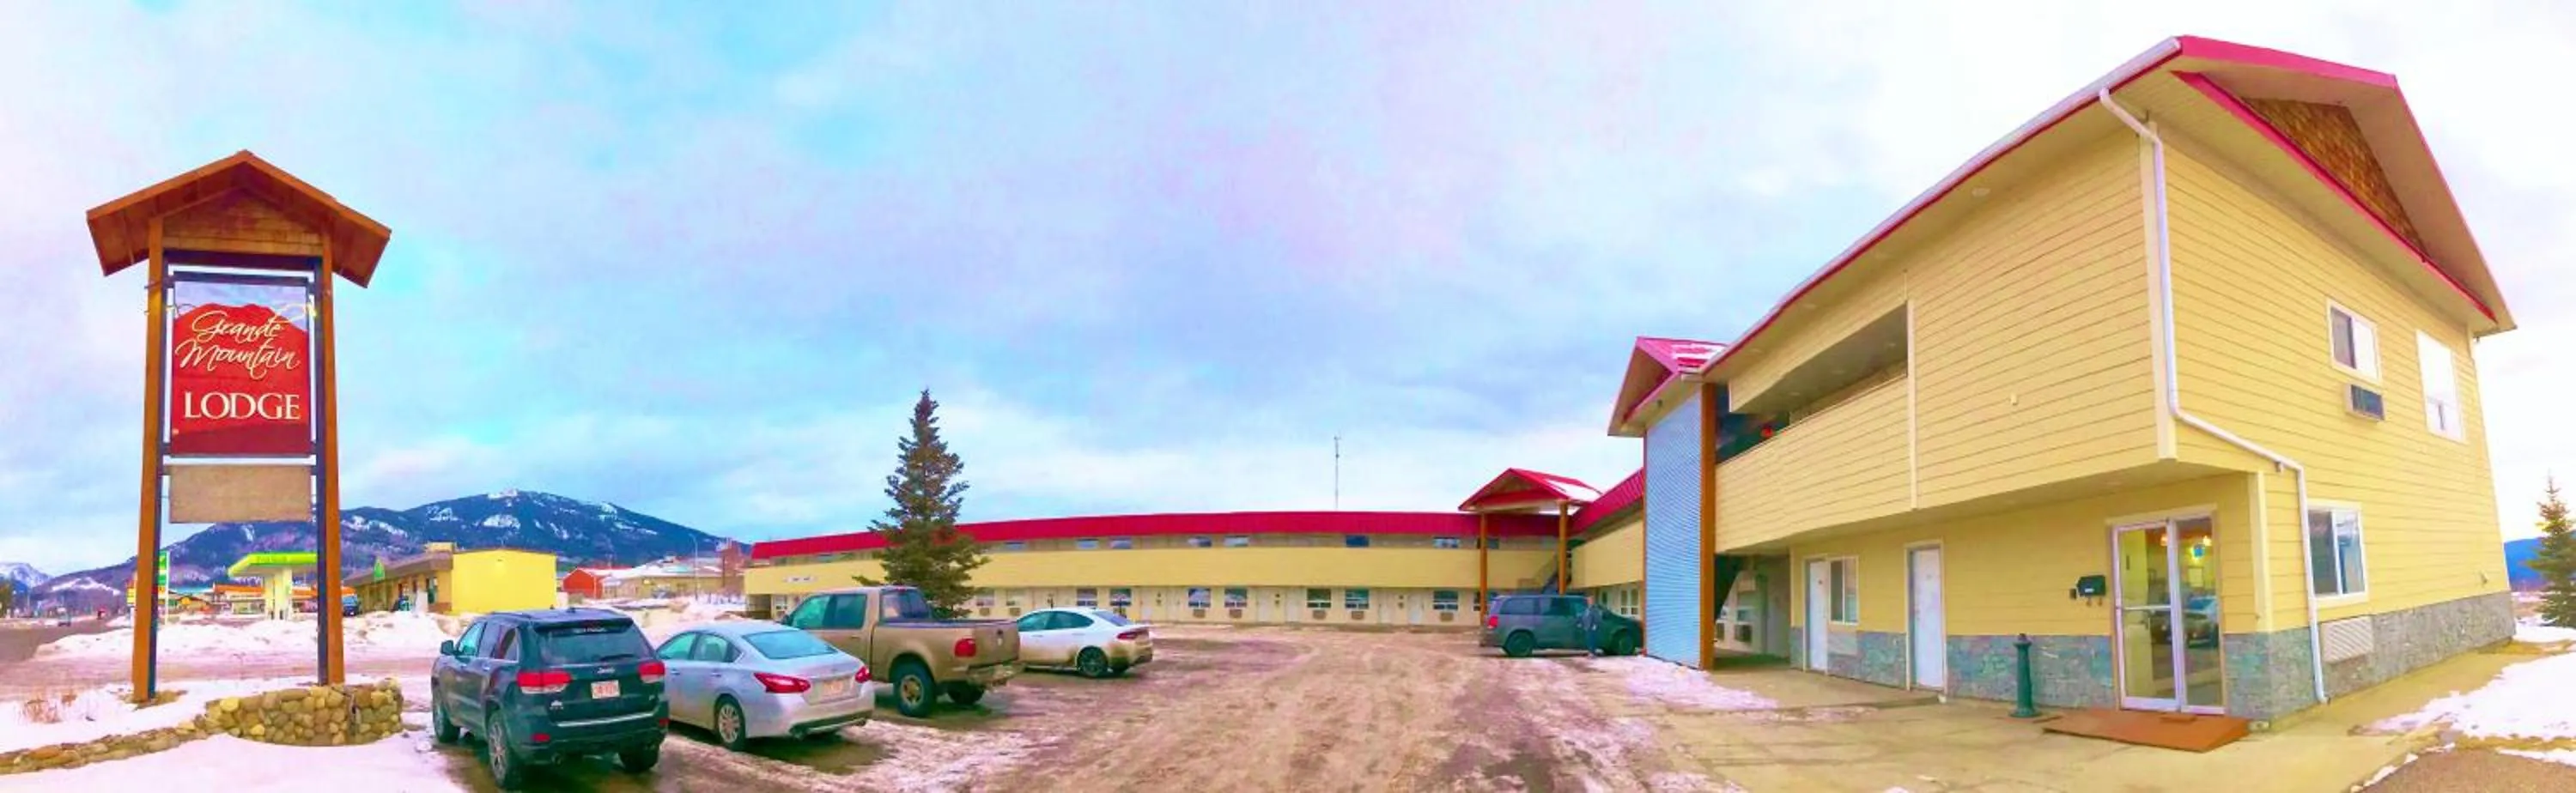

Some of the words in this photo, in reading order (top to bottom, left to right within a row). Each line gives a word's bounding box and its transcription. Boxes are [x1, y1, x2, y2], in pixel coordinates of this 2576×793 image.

[191, 310, 292, 343] Grande
[174, 337, 301, 379] Mountain
[184, 391, 301, 420] LODGE
